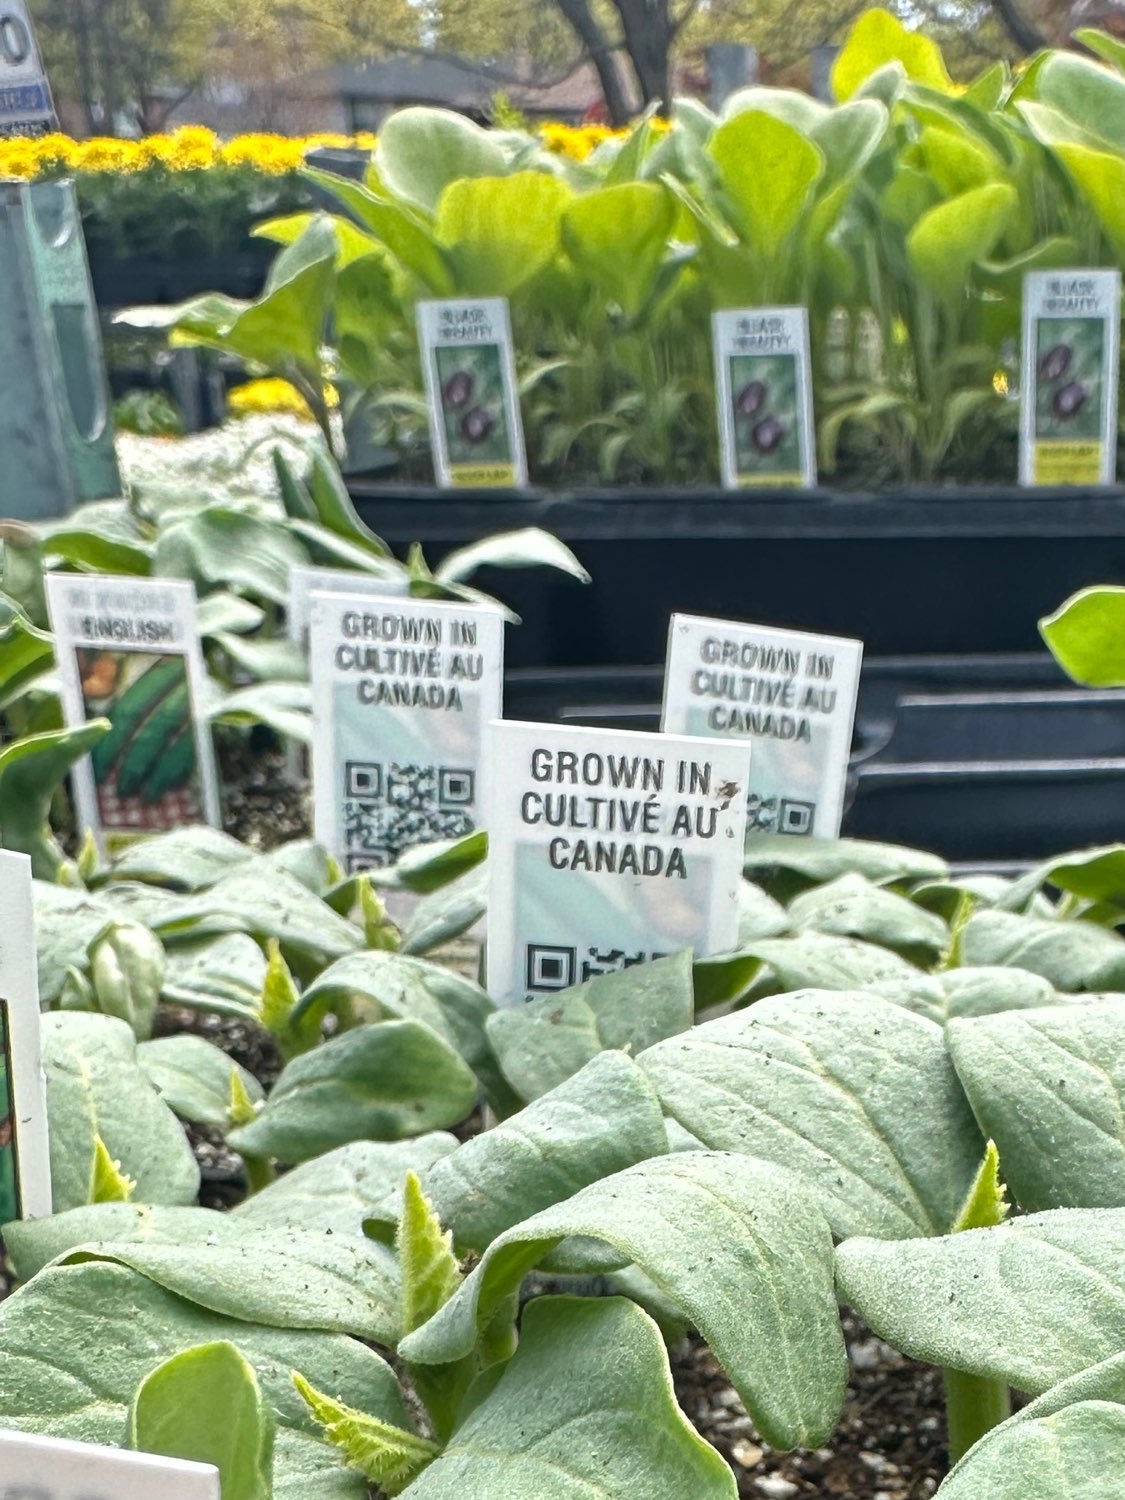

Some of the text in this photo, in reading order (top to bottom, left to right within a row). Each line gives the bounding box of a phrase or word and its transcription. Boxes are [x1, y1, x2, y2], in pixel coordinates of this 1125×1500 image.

[341, 611, 477, 646] GROWN IN
[449, 653, 484, 681] AU
[701, 637, 835, 680] GROWN IN
[357, 679, 463, 712] CANADA
[799, 685, 837, 714] AU
[707, 705, 811, 743] CANADA
[531, 748, 712, 796] GROWN IN
[521, 791, 718, 839] CULTIVÉ AU
[549, 837, 688, 880] CANADA
